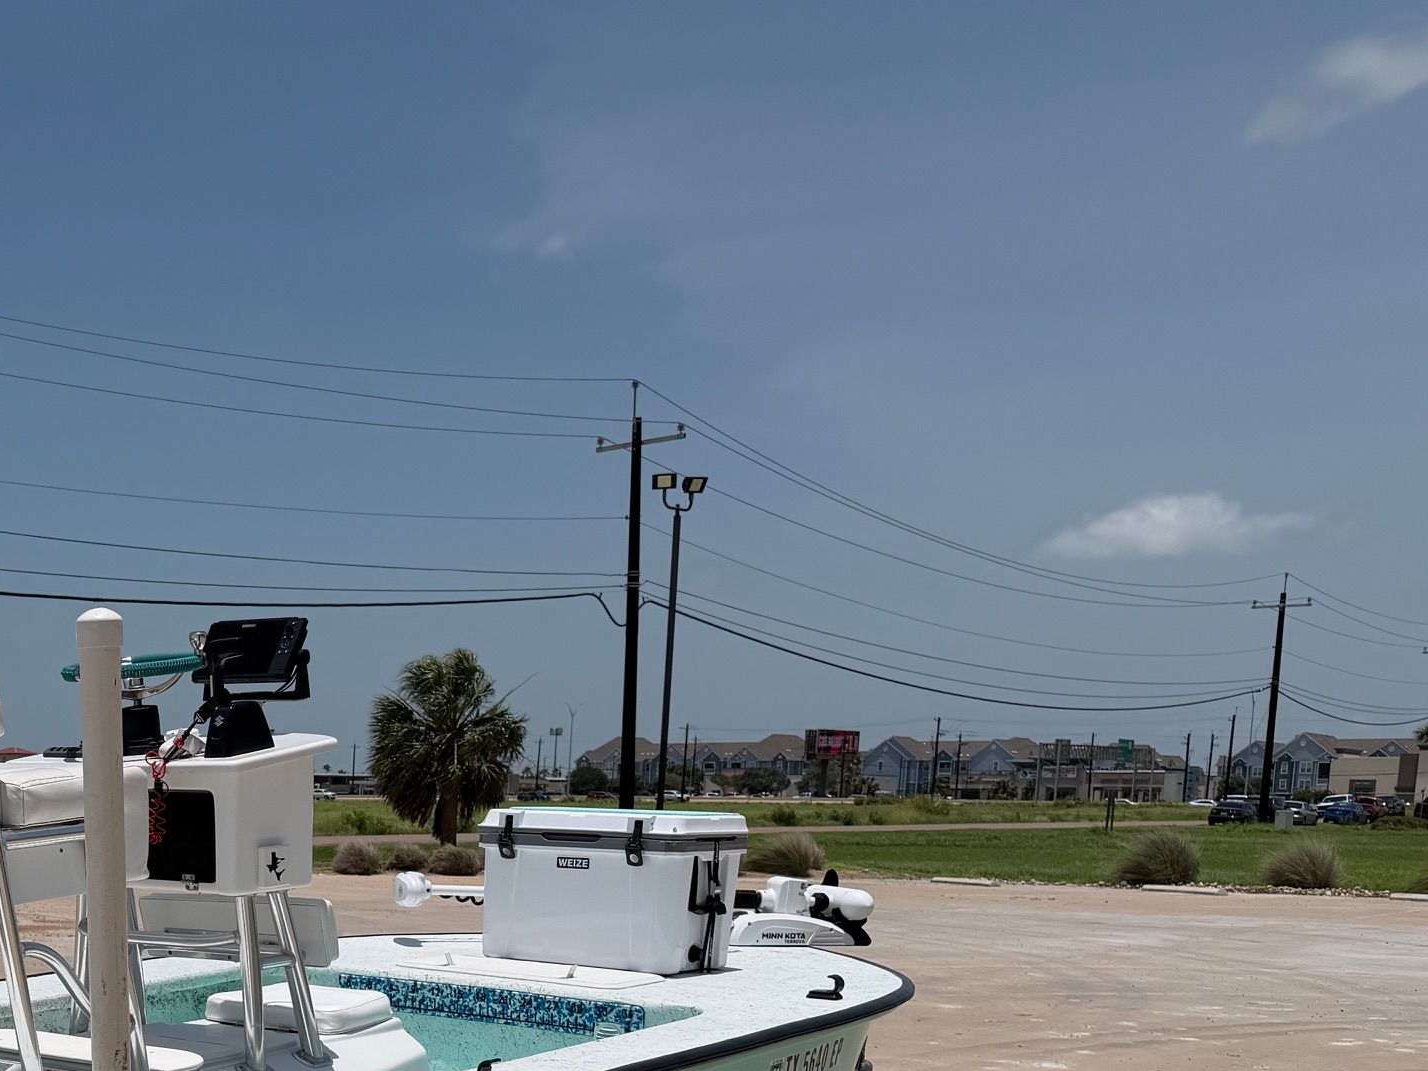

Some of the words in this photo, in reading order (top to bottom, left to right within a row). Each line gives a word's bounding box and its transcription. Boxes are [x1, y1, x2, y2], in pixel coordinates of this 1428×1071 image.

[557, 858, 589, 869] WEIZE
[761, 932, 784, 940] MINN
[785, 932, 806, 940] KOTA
